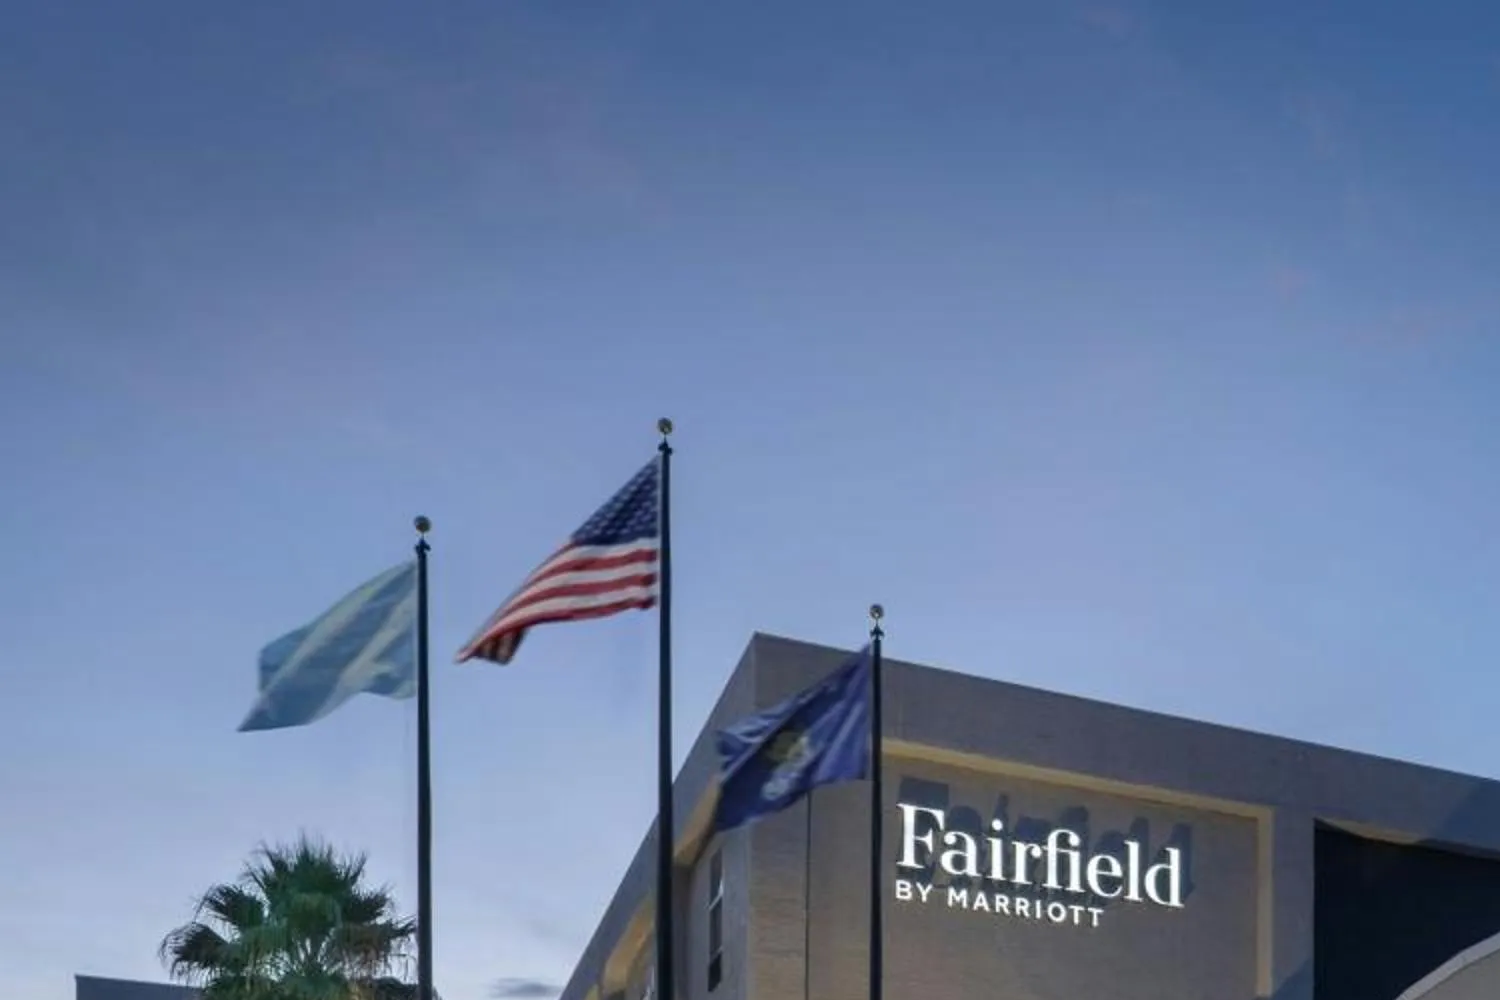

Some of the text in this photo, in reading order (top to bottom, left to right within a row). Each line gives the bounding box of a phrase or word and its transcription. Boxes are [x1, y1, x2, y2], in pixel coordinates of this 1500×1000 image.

[896, 803, 1184, 907] Fairfield
[895, 880, 1104, 928] BY MARRIOTT
